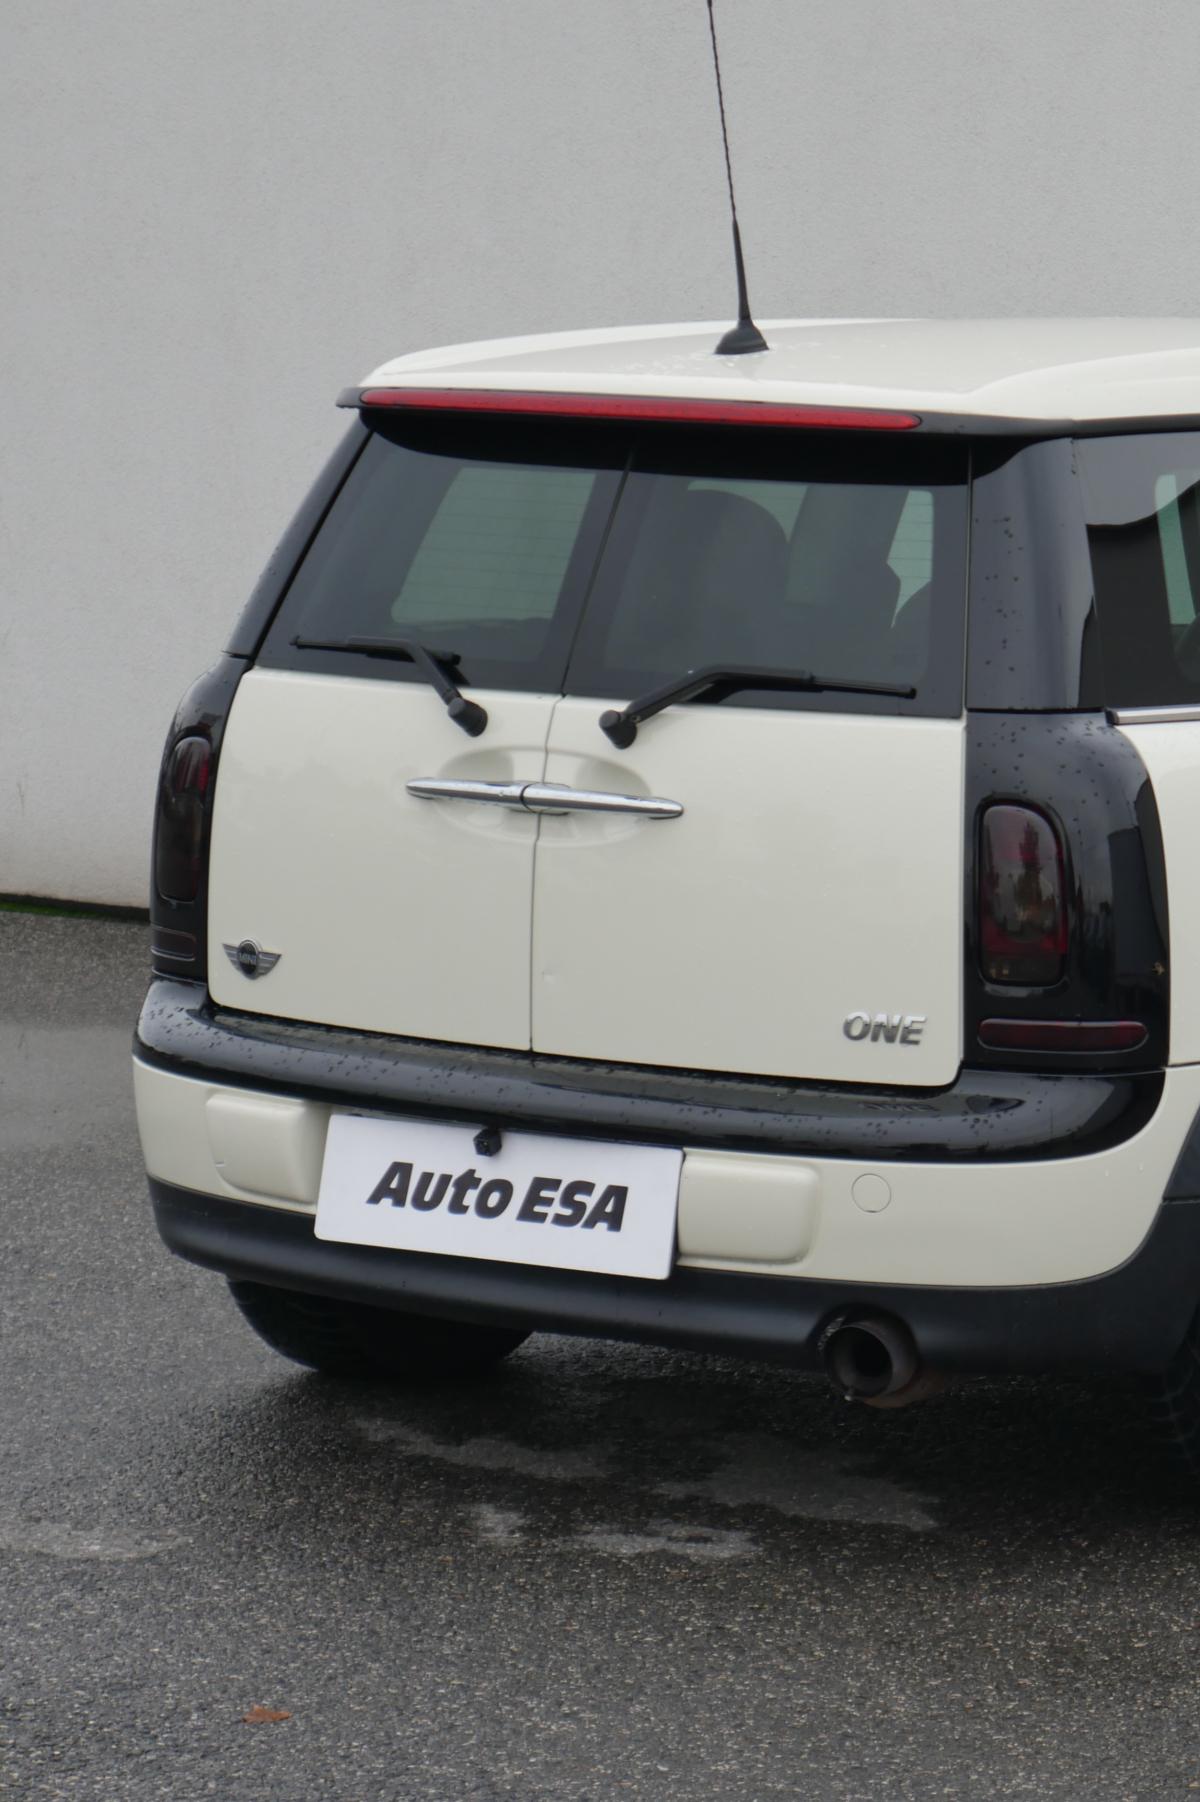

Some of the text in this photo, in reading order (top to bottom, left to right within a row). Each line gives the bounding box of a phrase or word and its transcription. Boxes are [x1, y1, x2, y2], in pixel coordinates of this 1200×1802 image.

[842, 1011, 927, 1046] ONE
[366, 1161, 629, 1232] Auto ESA
